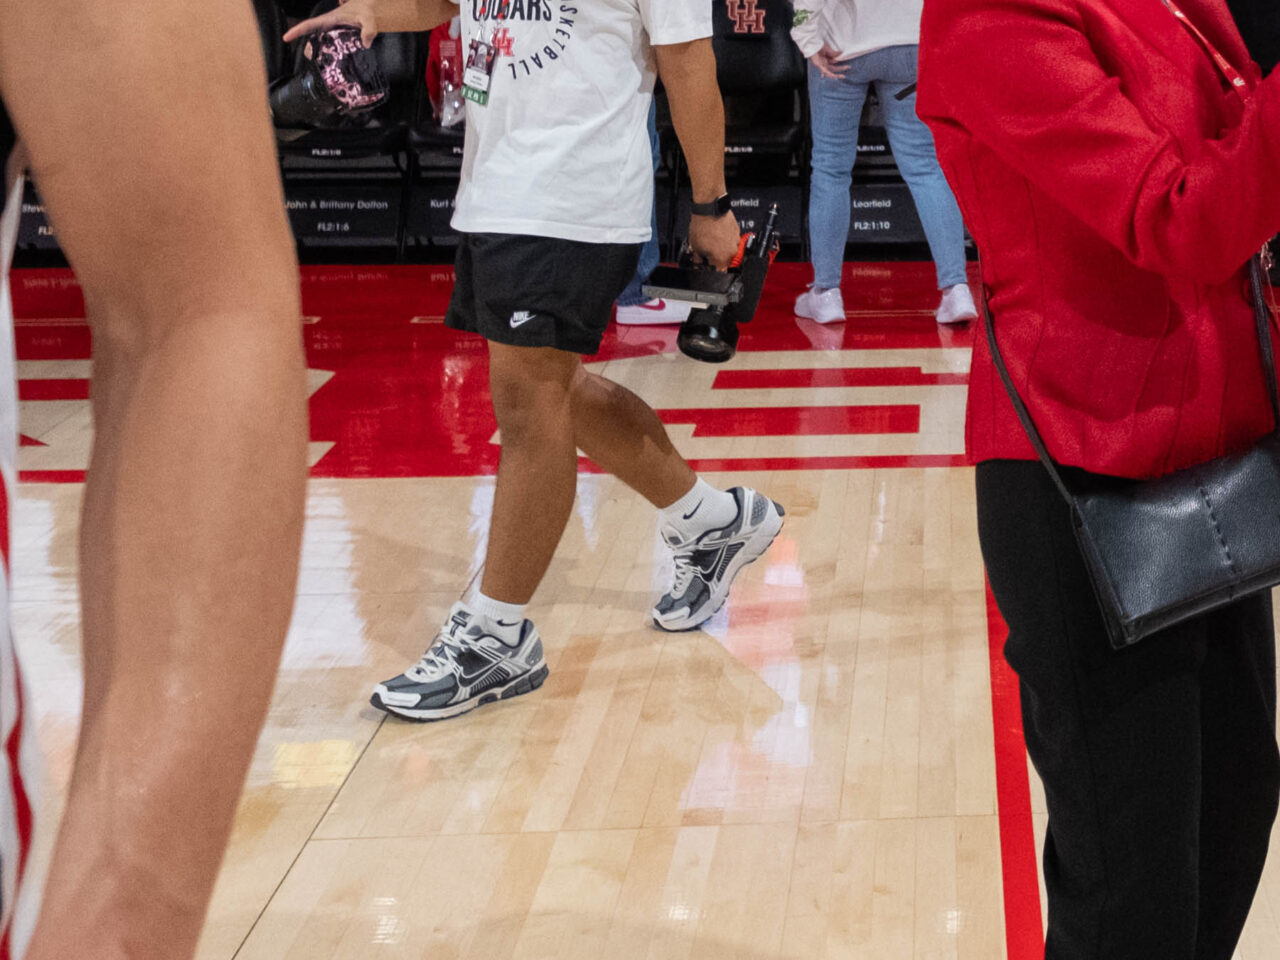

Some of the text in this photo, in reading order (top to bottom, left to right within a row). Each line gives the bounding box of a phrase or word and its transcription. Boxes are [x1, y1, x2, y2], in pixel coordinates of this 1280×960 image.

[319, 200, 355, 211] Brittany
[357, 200, 389, 209] Dalton
[853, 199, 892, 208] Learfield
[854, 221, 890, 230] FL2:1:10
